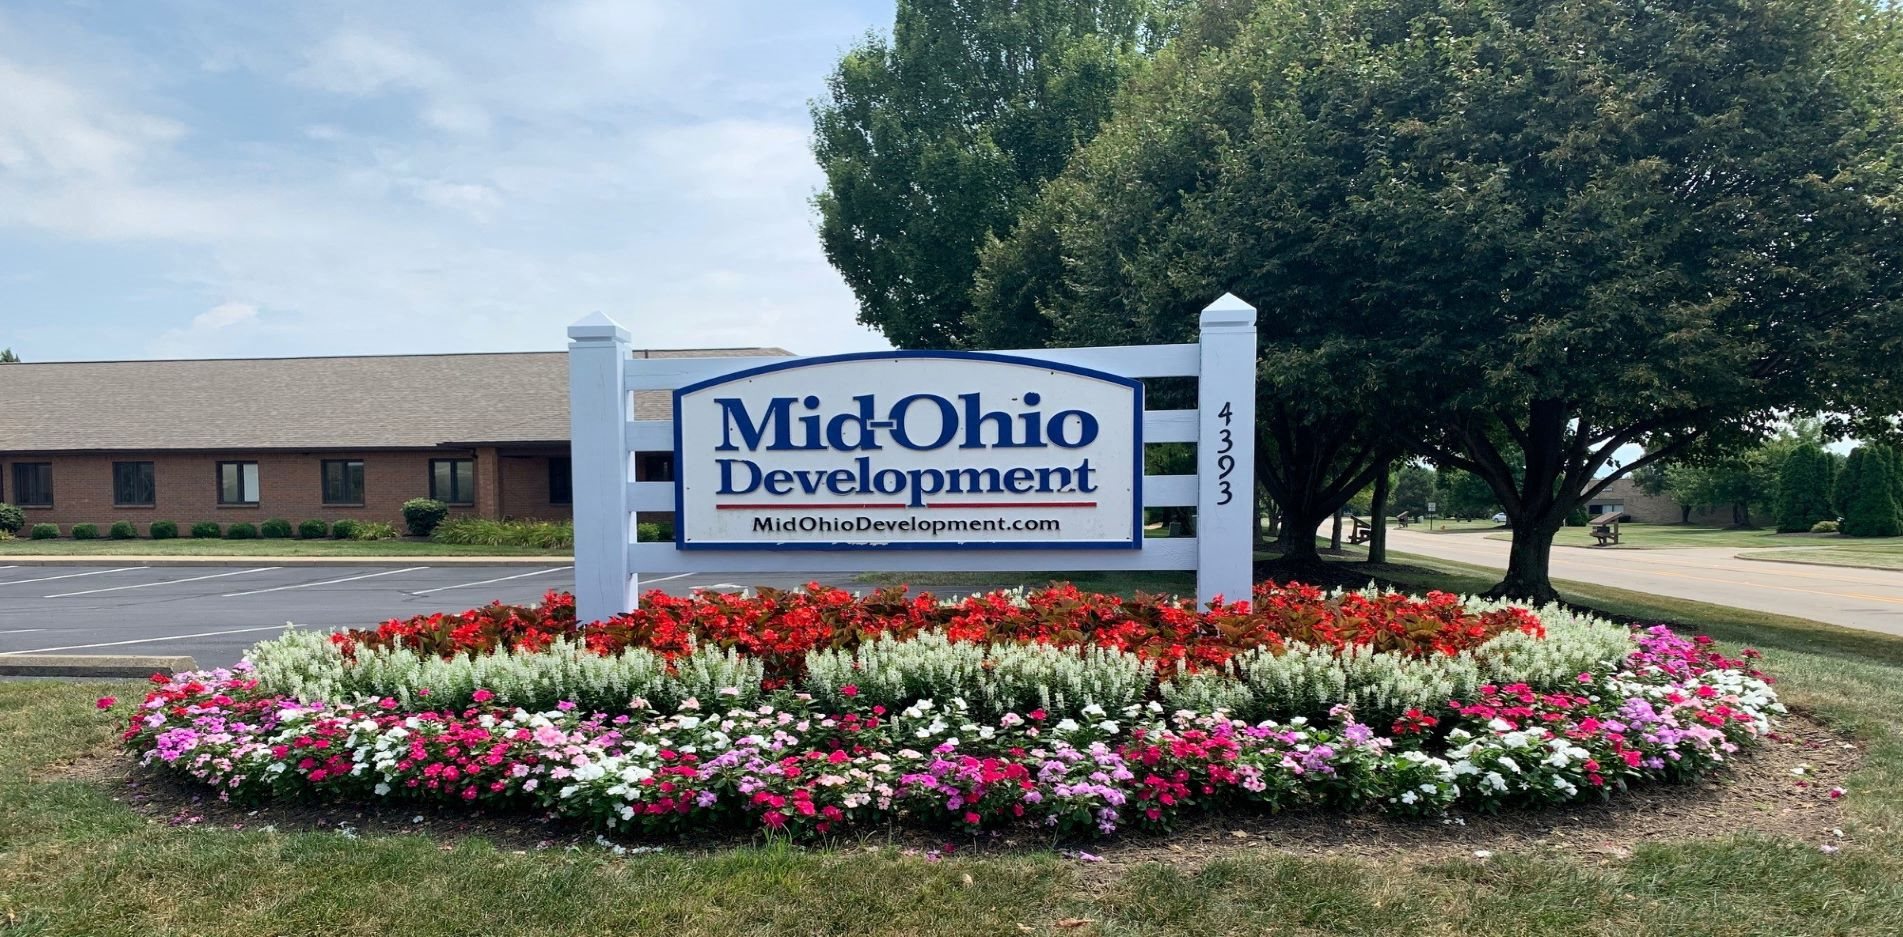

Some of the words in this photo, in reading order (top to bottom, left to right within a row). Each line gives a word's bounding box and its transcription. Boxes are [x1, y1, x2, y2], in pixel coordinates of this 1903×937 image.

[714, 392, 1099, 451] Mid-Ohio
[1216, 401, 1235, 505] 4393
[715, 456, 1098, 507] Development
[752, 516, 1061, 535] MidOhioDevelopment.com
